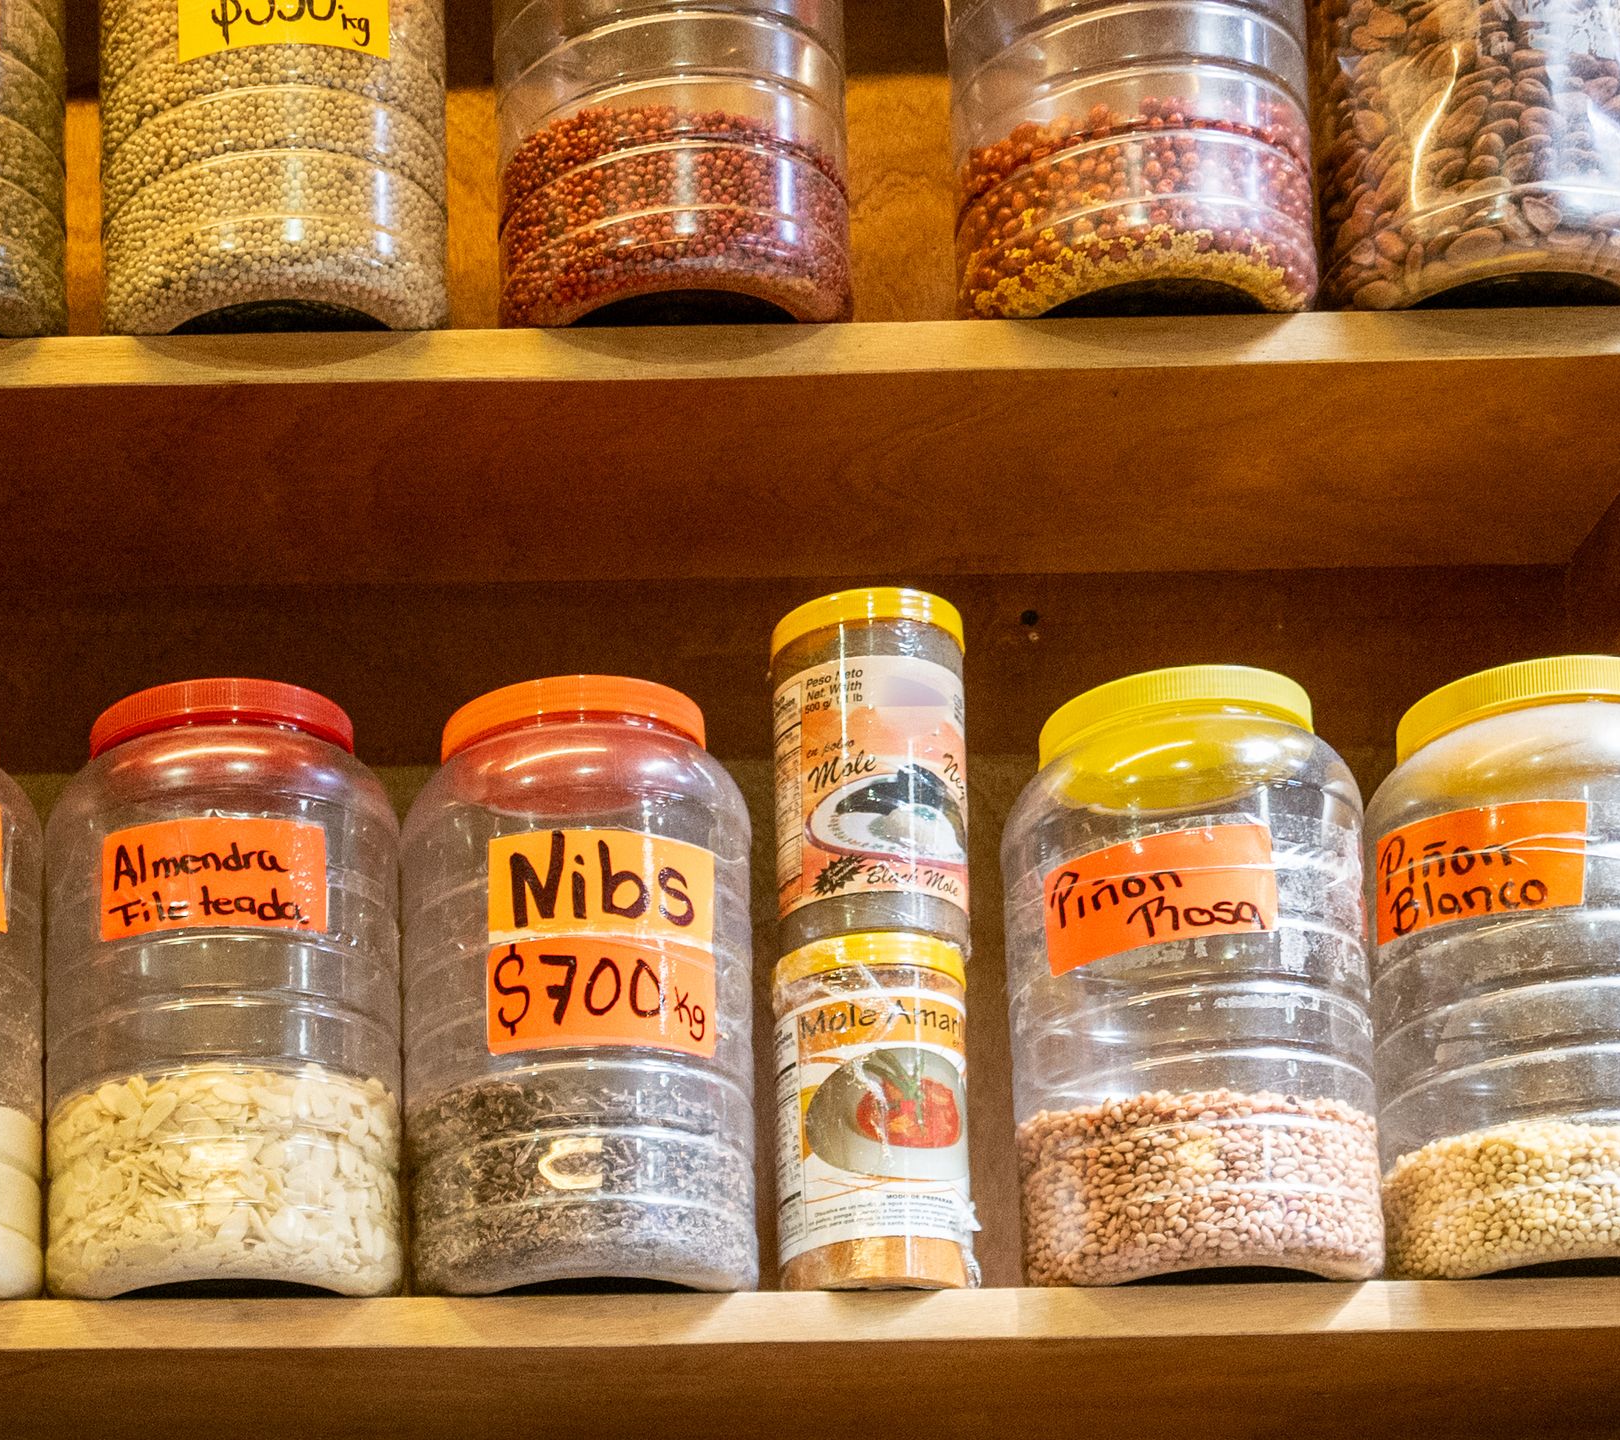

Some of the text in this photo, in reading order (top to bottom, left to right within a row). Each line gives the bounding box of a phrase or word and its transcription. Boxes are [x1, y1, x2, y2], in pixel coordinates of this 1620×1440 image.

[805, 675, 832, 690] Peso
[807, 749, 877, 793] Mole
[113, 842, 290, 892] Almendra
[509, 830, 695, 928] Nibs
[923, 869, 960, 897] Mole
[1126, 896, 1266, 938] Rosa
[1390, 879, 1548, 936] Blanco
[493, 943, 666, 1037] $700
[800, 1003, 877, 1040] Mole
